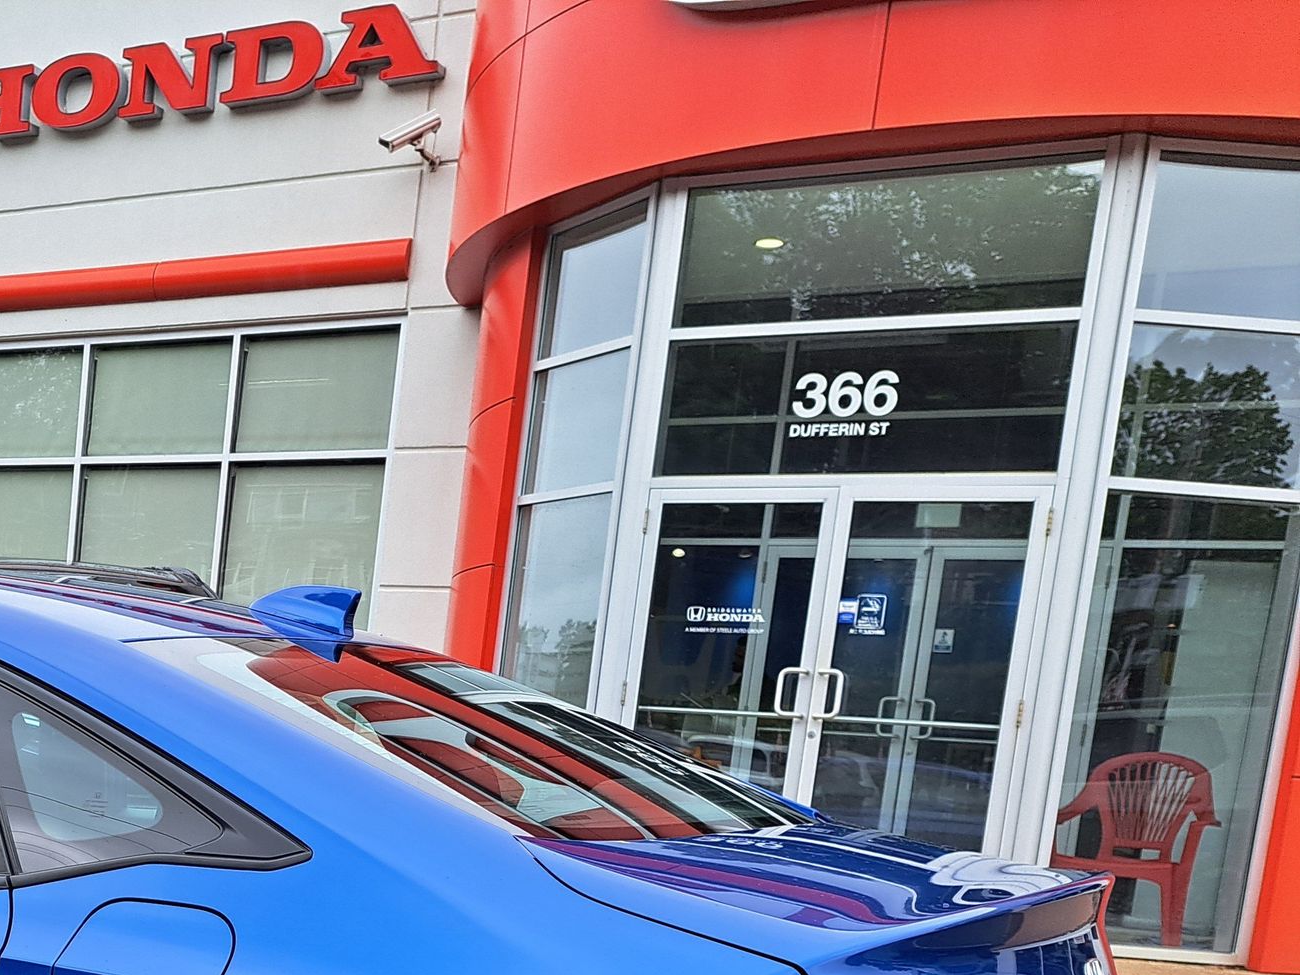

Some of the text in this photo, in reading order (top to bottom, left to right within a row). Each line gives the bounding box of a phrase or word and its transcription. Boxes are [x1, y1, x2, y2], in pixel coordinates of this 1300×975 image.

[792, 369, 900, 418] 366
[788, 421, 891, 438] DUFFERIN ST
[706, 613, 766, 623] HONDA
